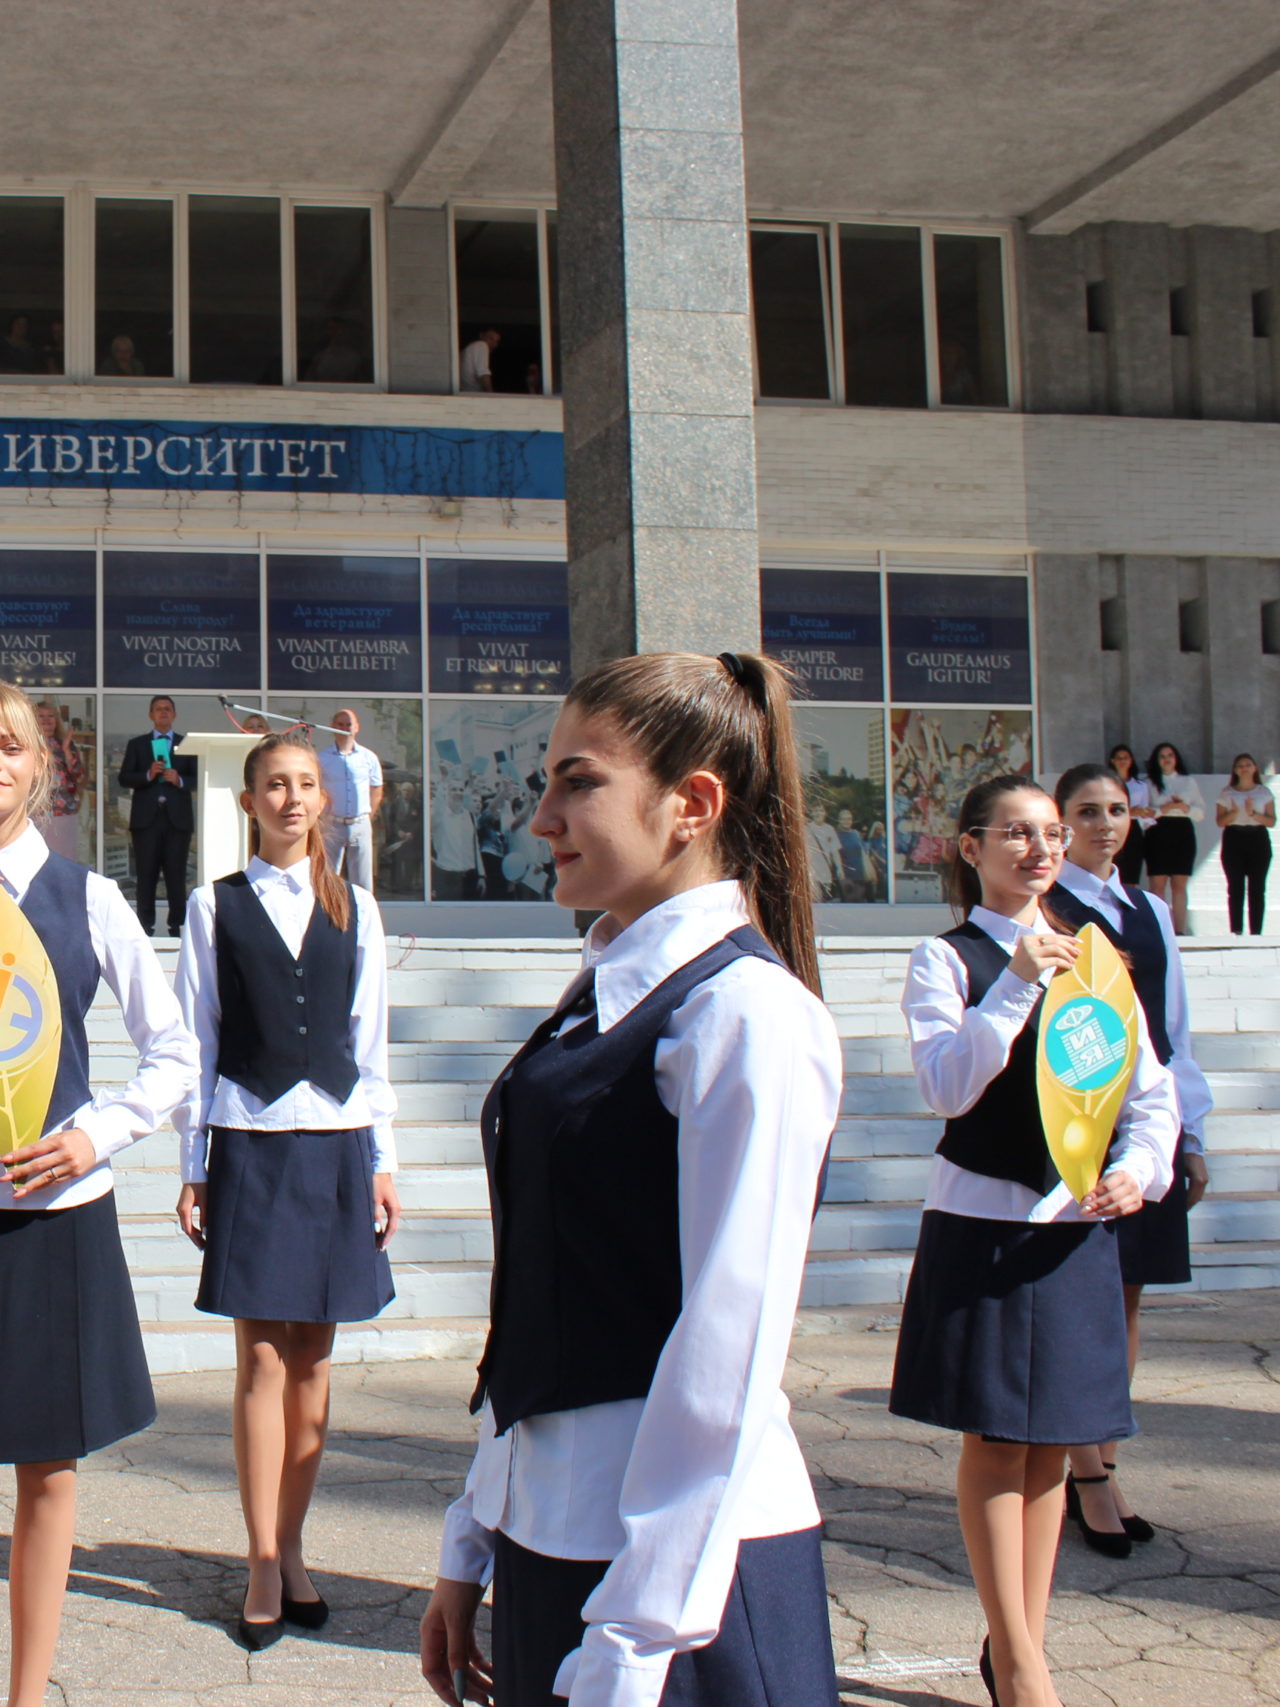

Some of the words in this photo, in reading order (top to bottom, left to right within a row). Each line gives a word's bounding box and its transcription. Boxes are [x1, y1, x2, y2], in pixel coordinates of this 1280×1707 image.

[121, 635, 172, 650] VIVAT
[173, 636, 243, 652] NOSTRA
[277, 638, 338, 653] VIVANT
[340, 640, 411, 655] MEMBRA
[477, 642, 530, 657] VIVAT
[144, 652, 221, 668] CIVITAS!
[291, 655, 397, 672] QUAELIBET!
[446, 657, 465, 672] ET
[780, 649, 838, 665] SEMPER
[906, 652, 1012, 669] GAUDEAMUS
[928, 669, 992, 684] IGITUR!
